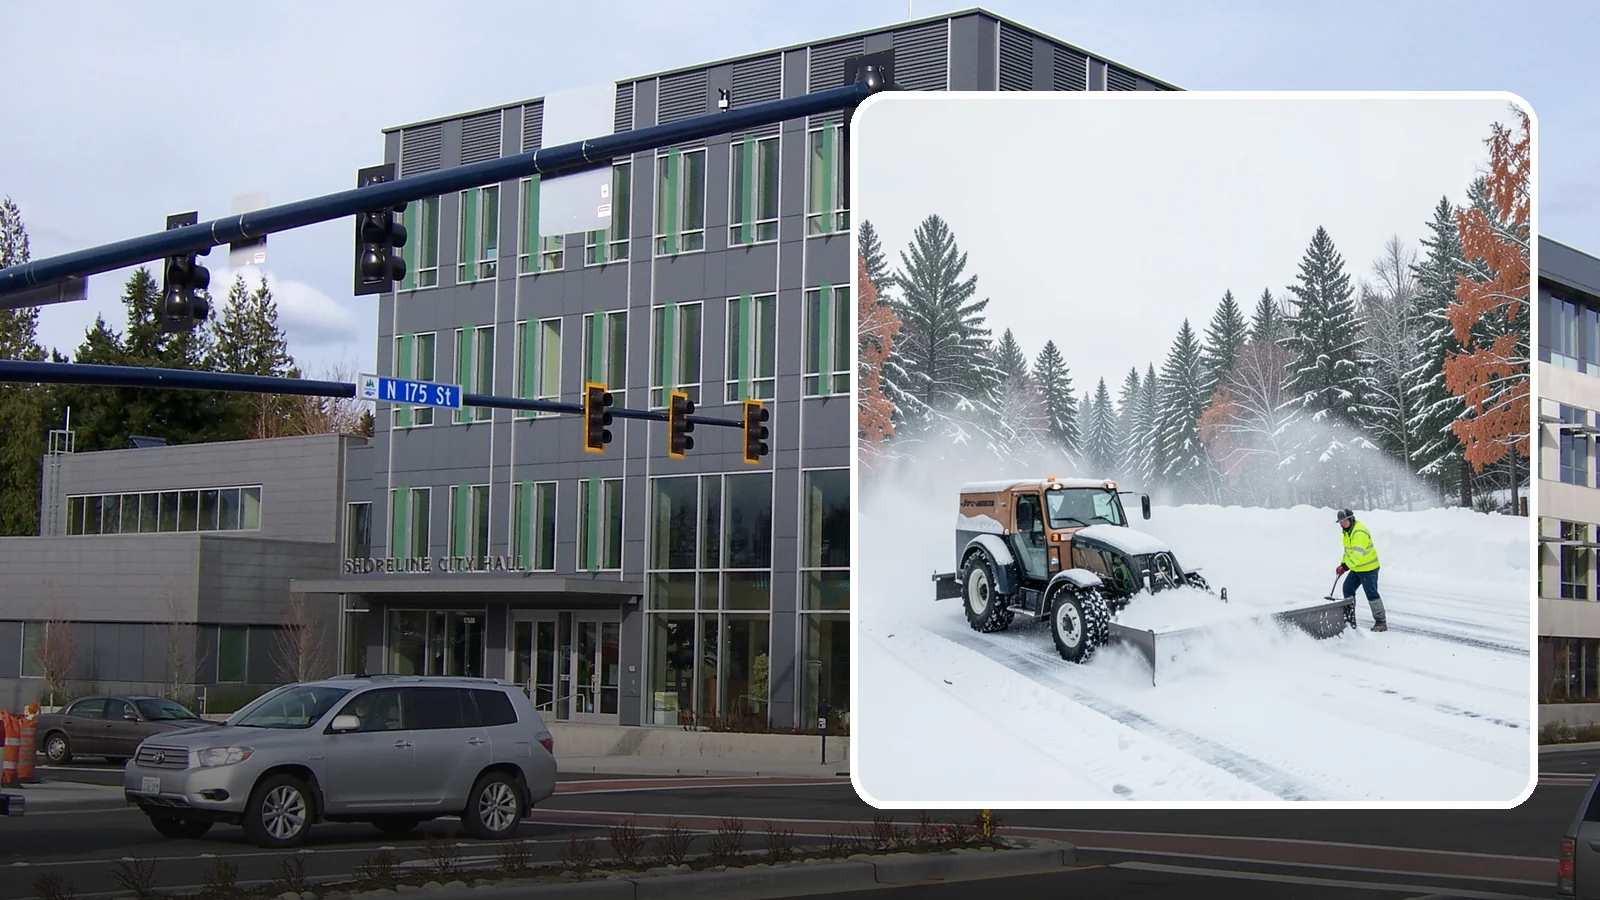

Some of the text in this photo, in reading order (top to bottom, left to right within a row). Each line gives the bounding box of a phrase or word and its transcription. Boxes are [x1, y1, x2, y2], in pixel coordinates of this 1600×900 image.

[387, 380, 451, 406] N 175 St
[344, 556, 526, 574] SHORELINE CITY HALL
